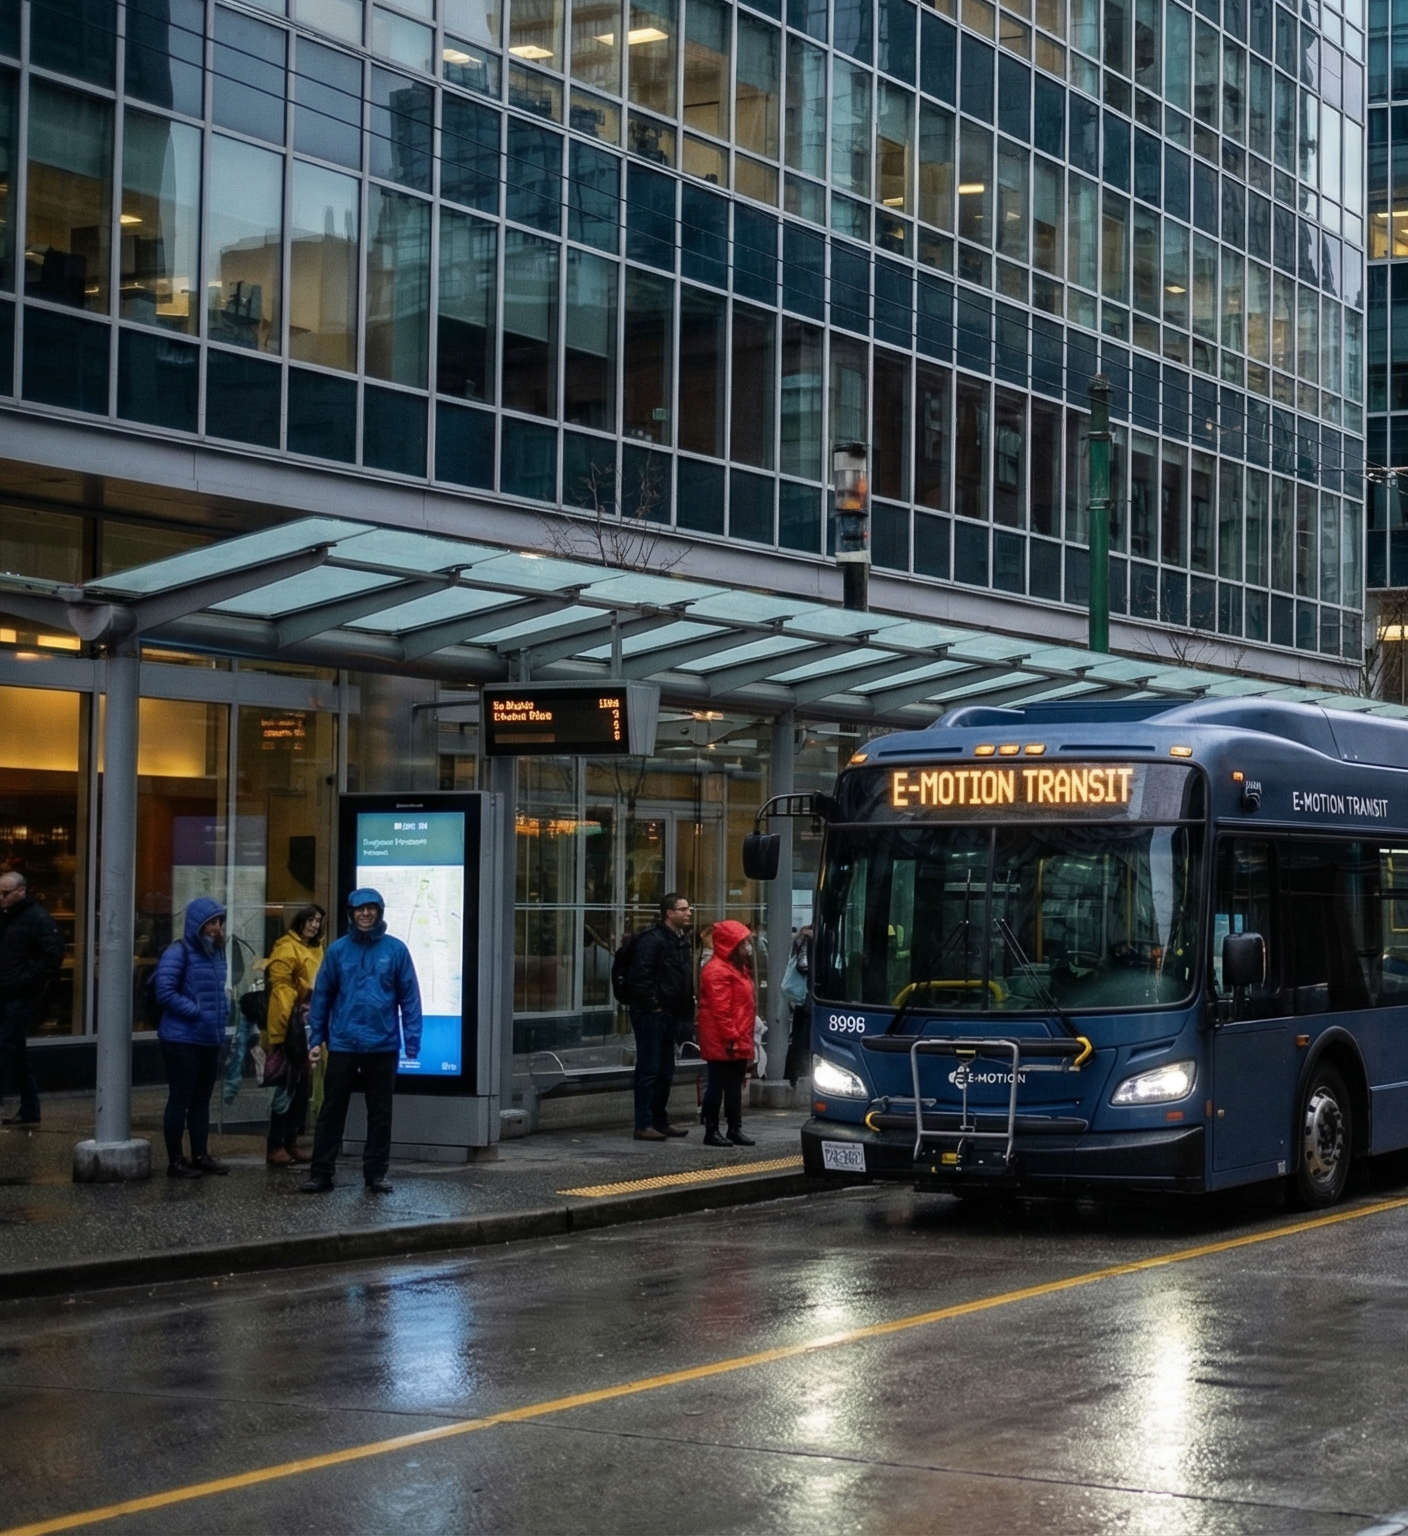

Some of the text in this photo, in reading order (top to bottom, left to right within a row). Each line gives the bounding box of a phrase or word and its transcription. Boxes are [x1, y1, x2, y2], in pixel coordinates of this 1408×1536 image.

[893, 768, 1133, 806] E-MOTION TRANSIT
[1293, 791, 1388, 818] E-MOTION TRANSIT
[968, 1073, 1026, 1083] E-MOTION
